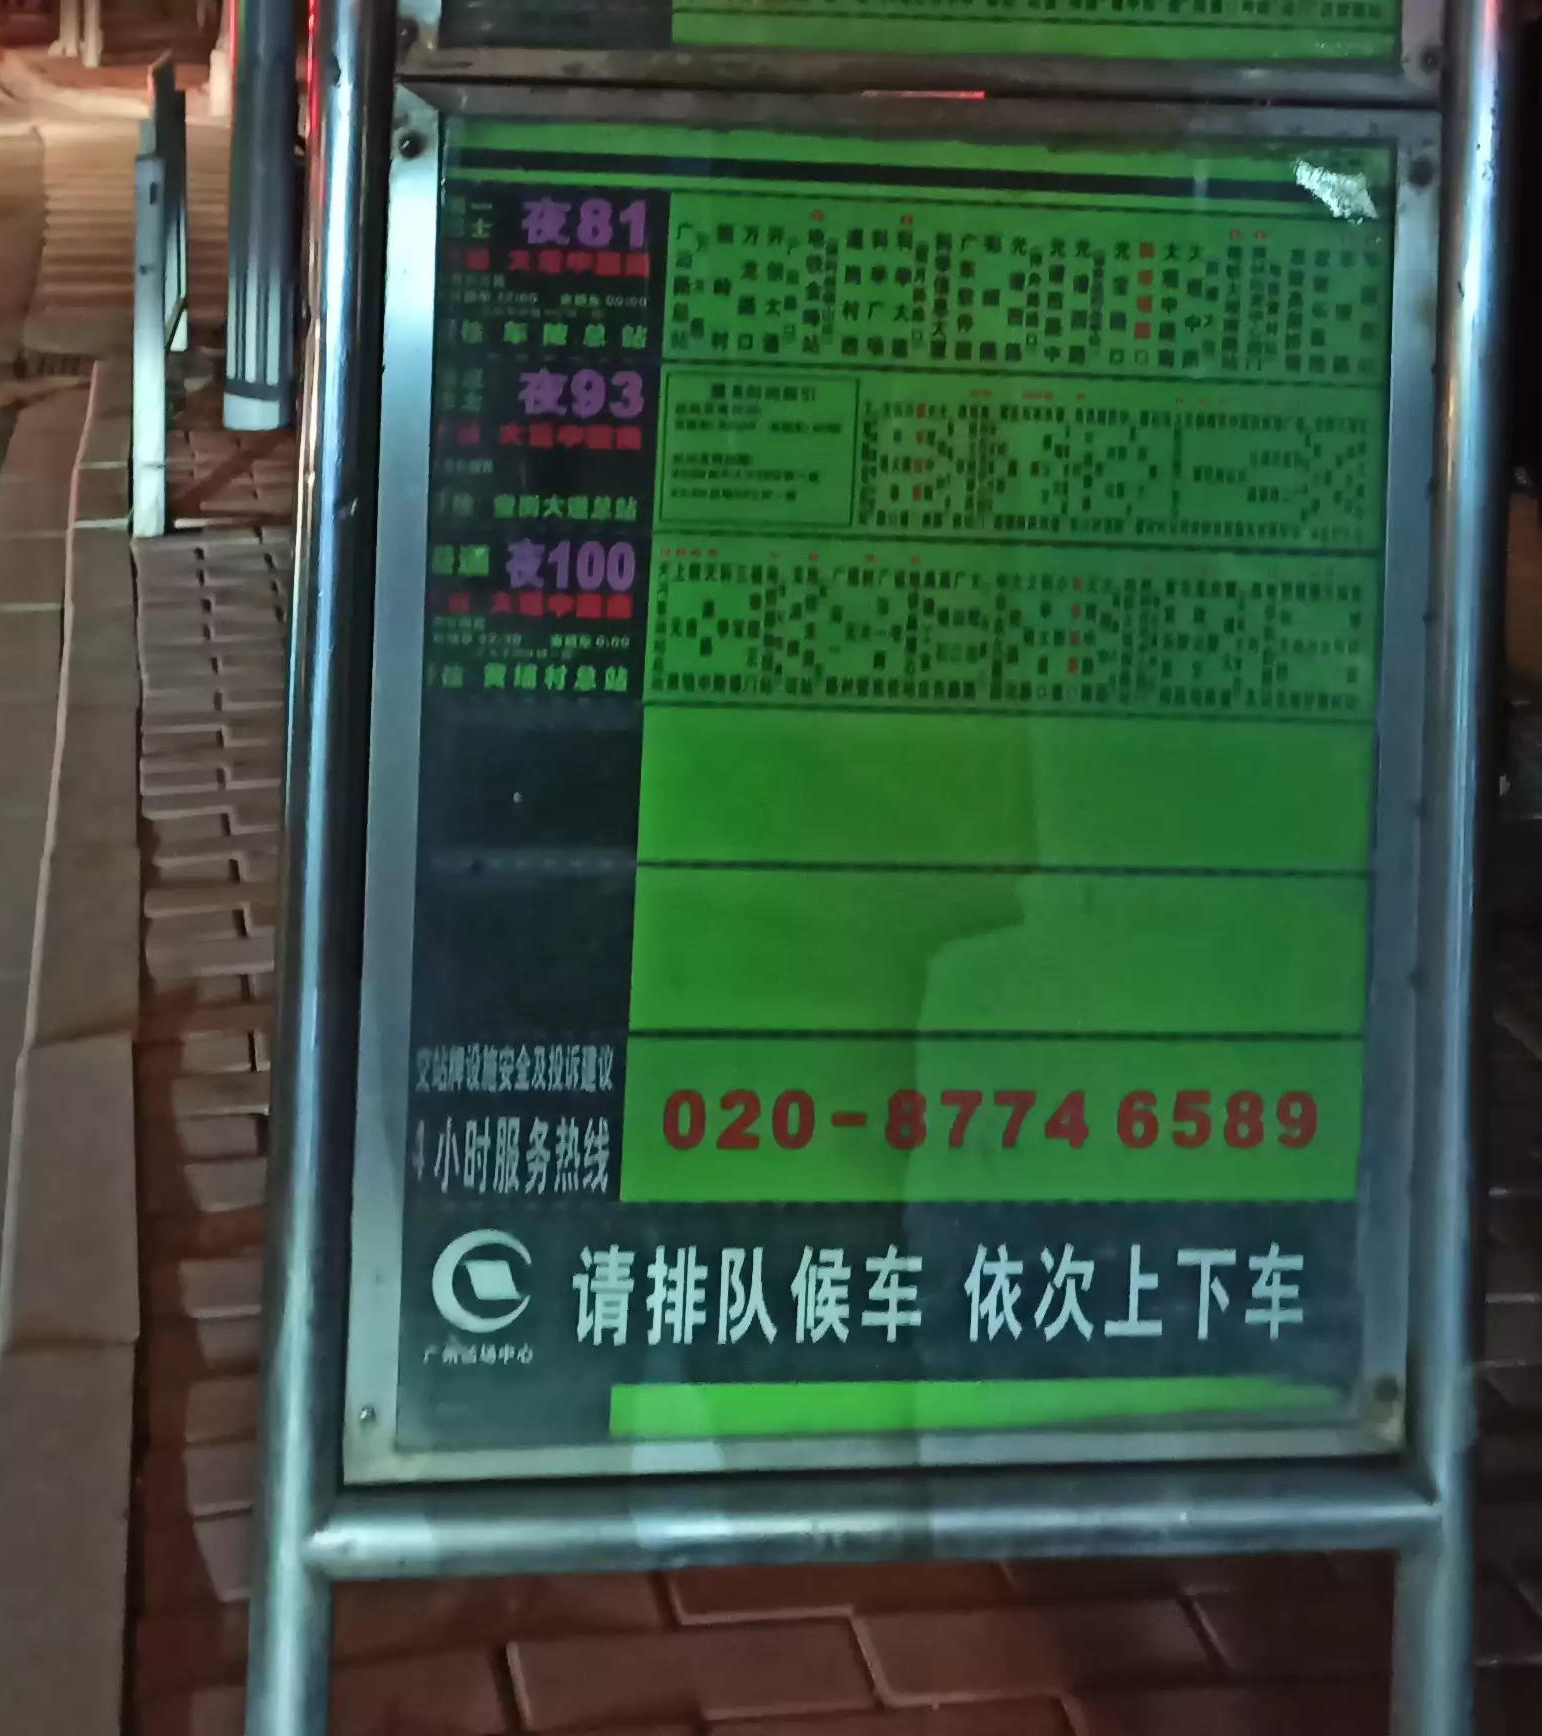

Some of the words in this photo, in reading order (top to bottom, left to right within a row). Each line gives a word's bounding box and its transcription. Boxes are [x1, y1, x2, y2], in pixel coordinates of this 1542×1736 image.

[521, 197, 646, 249] 夜81
[519, 366, 644, 419] 夜93
[505, 538, 636, 592] 夜100
[573, 1244, 923, 1345] 请排队候车
[964, 1241, 1304, 1342] 依次上下车
